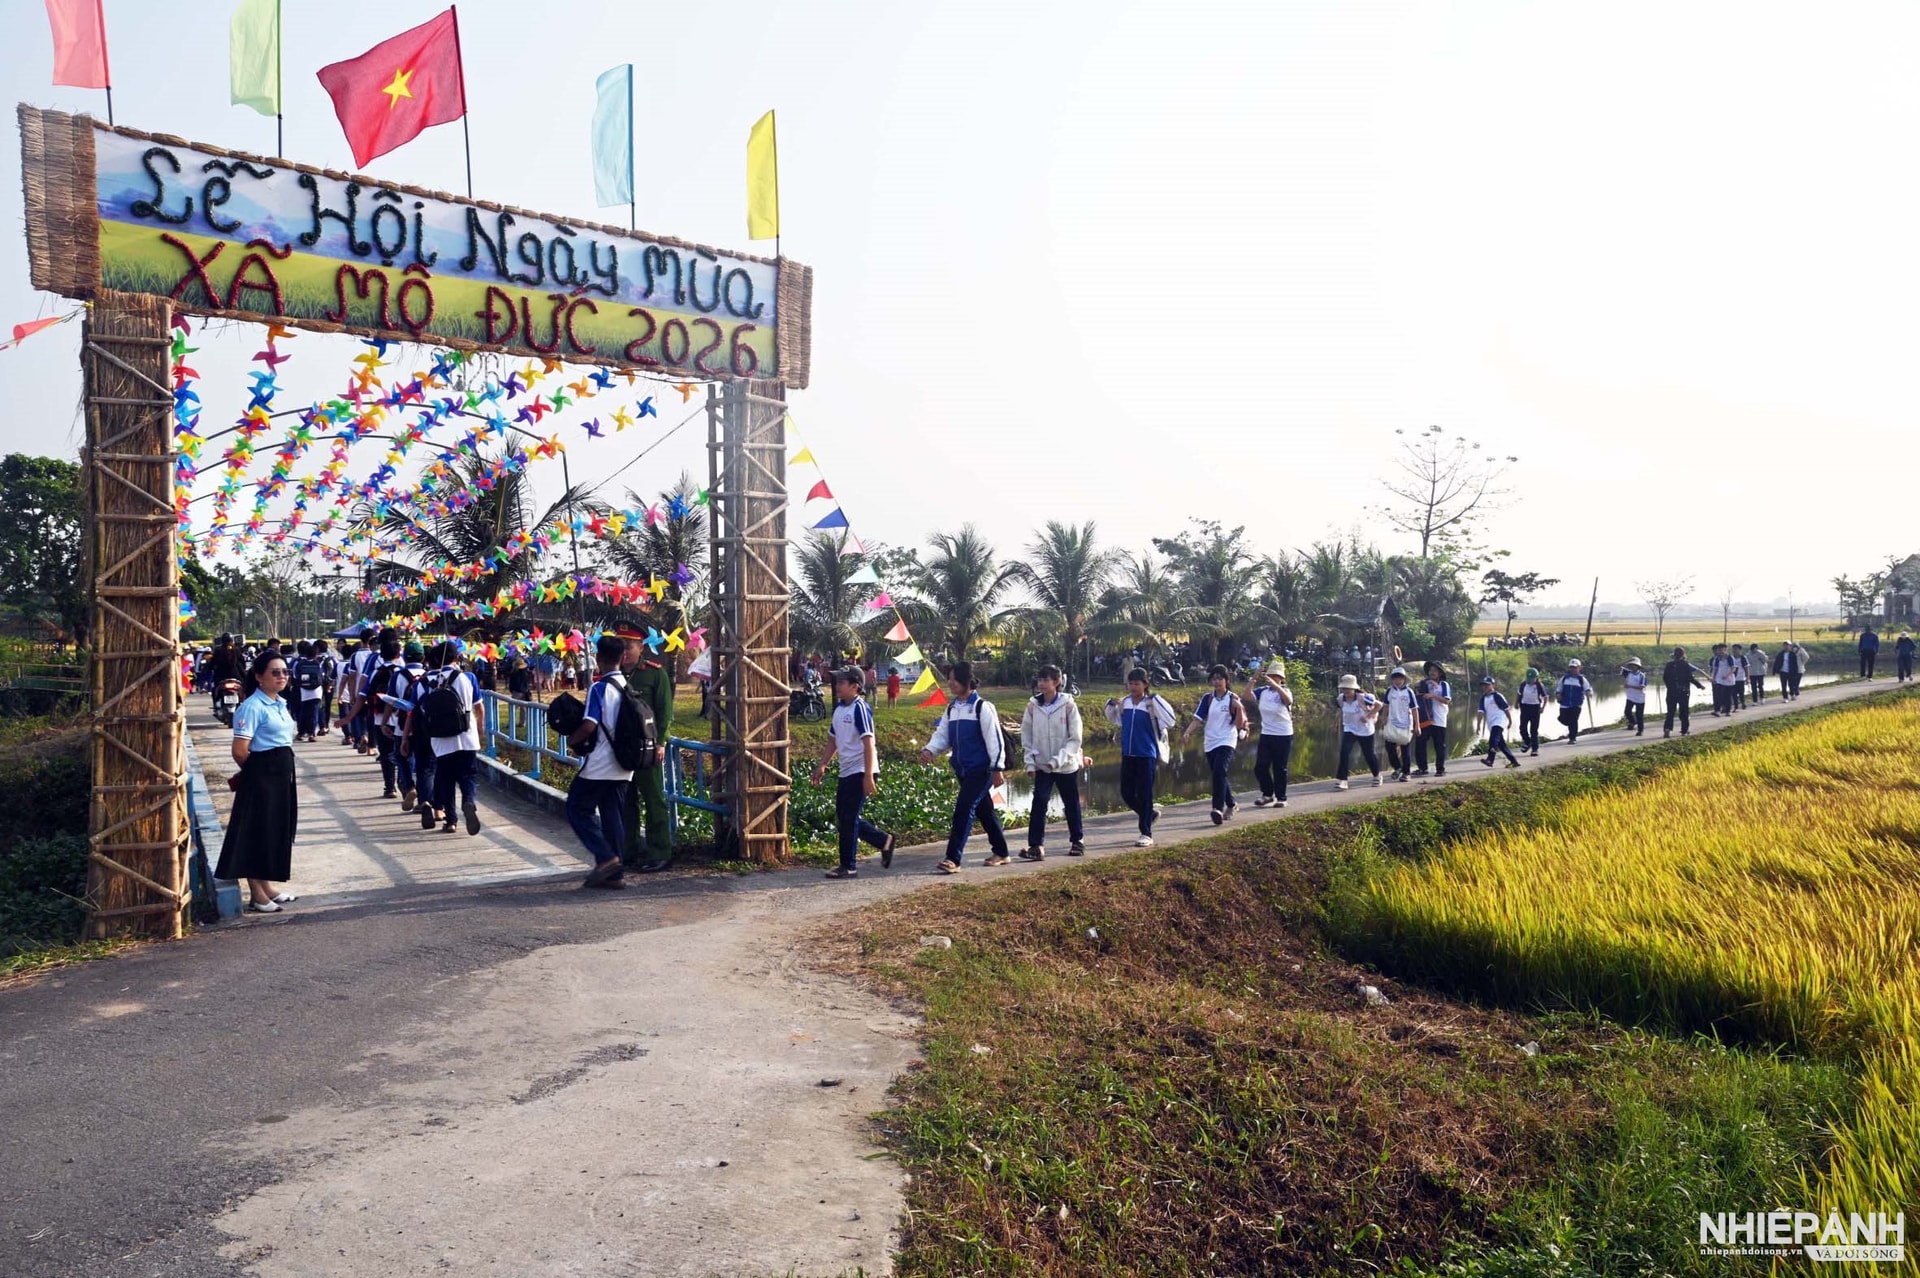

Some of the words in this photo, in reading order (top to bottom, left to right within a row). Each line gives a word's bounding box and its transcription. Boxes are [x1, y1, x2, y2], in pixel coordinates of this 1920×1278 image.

[131, 146, 276, 233] Lễ
[297, 172, 438, 267] Hội
[460, 206, 620, 297] Ngày
[161, 232, 293, 316] XÃ
[475, 286, 600, 355] ĐỨC
[625, 307, 760, 378] 2026
